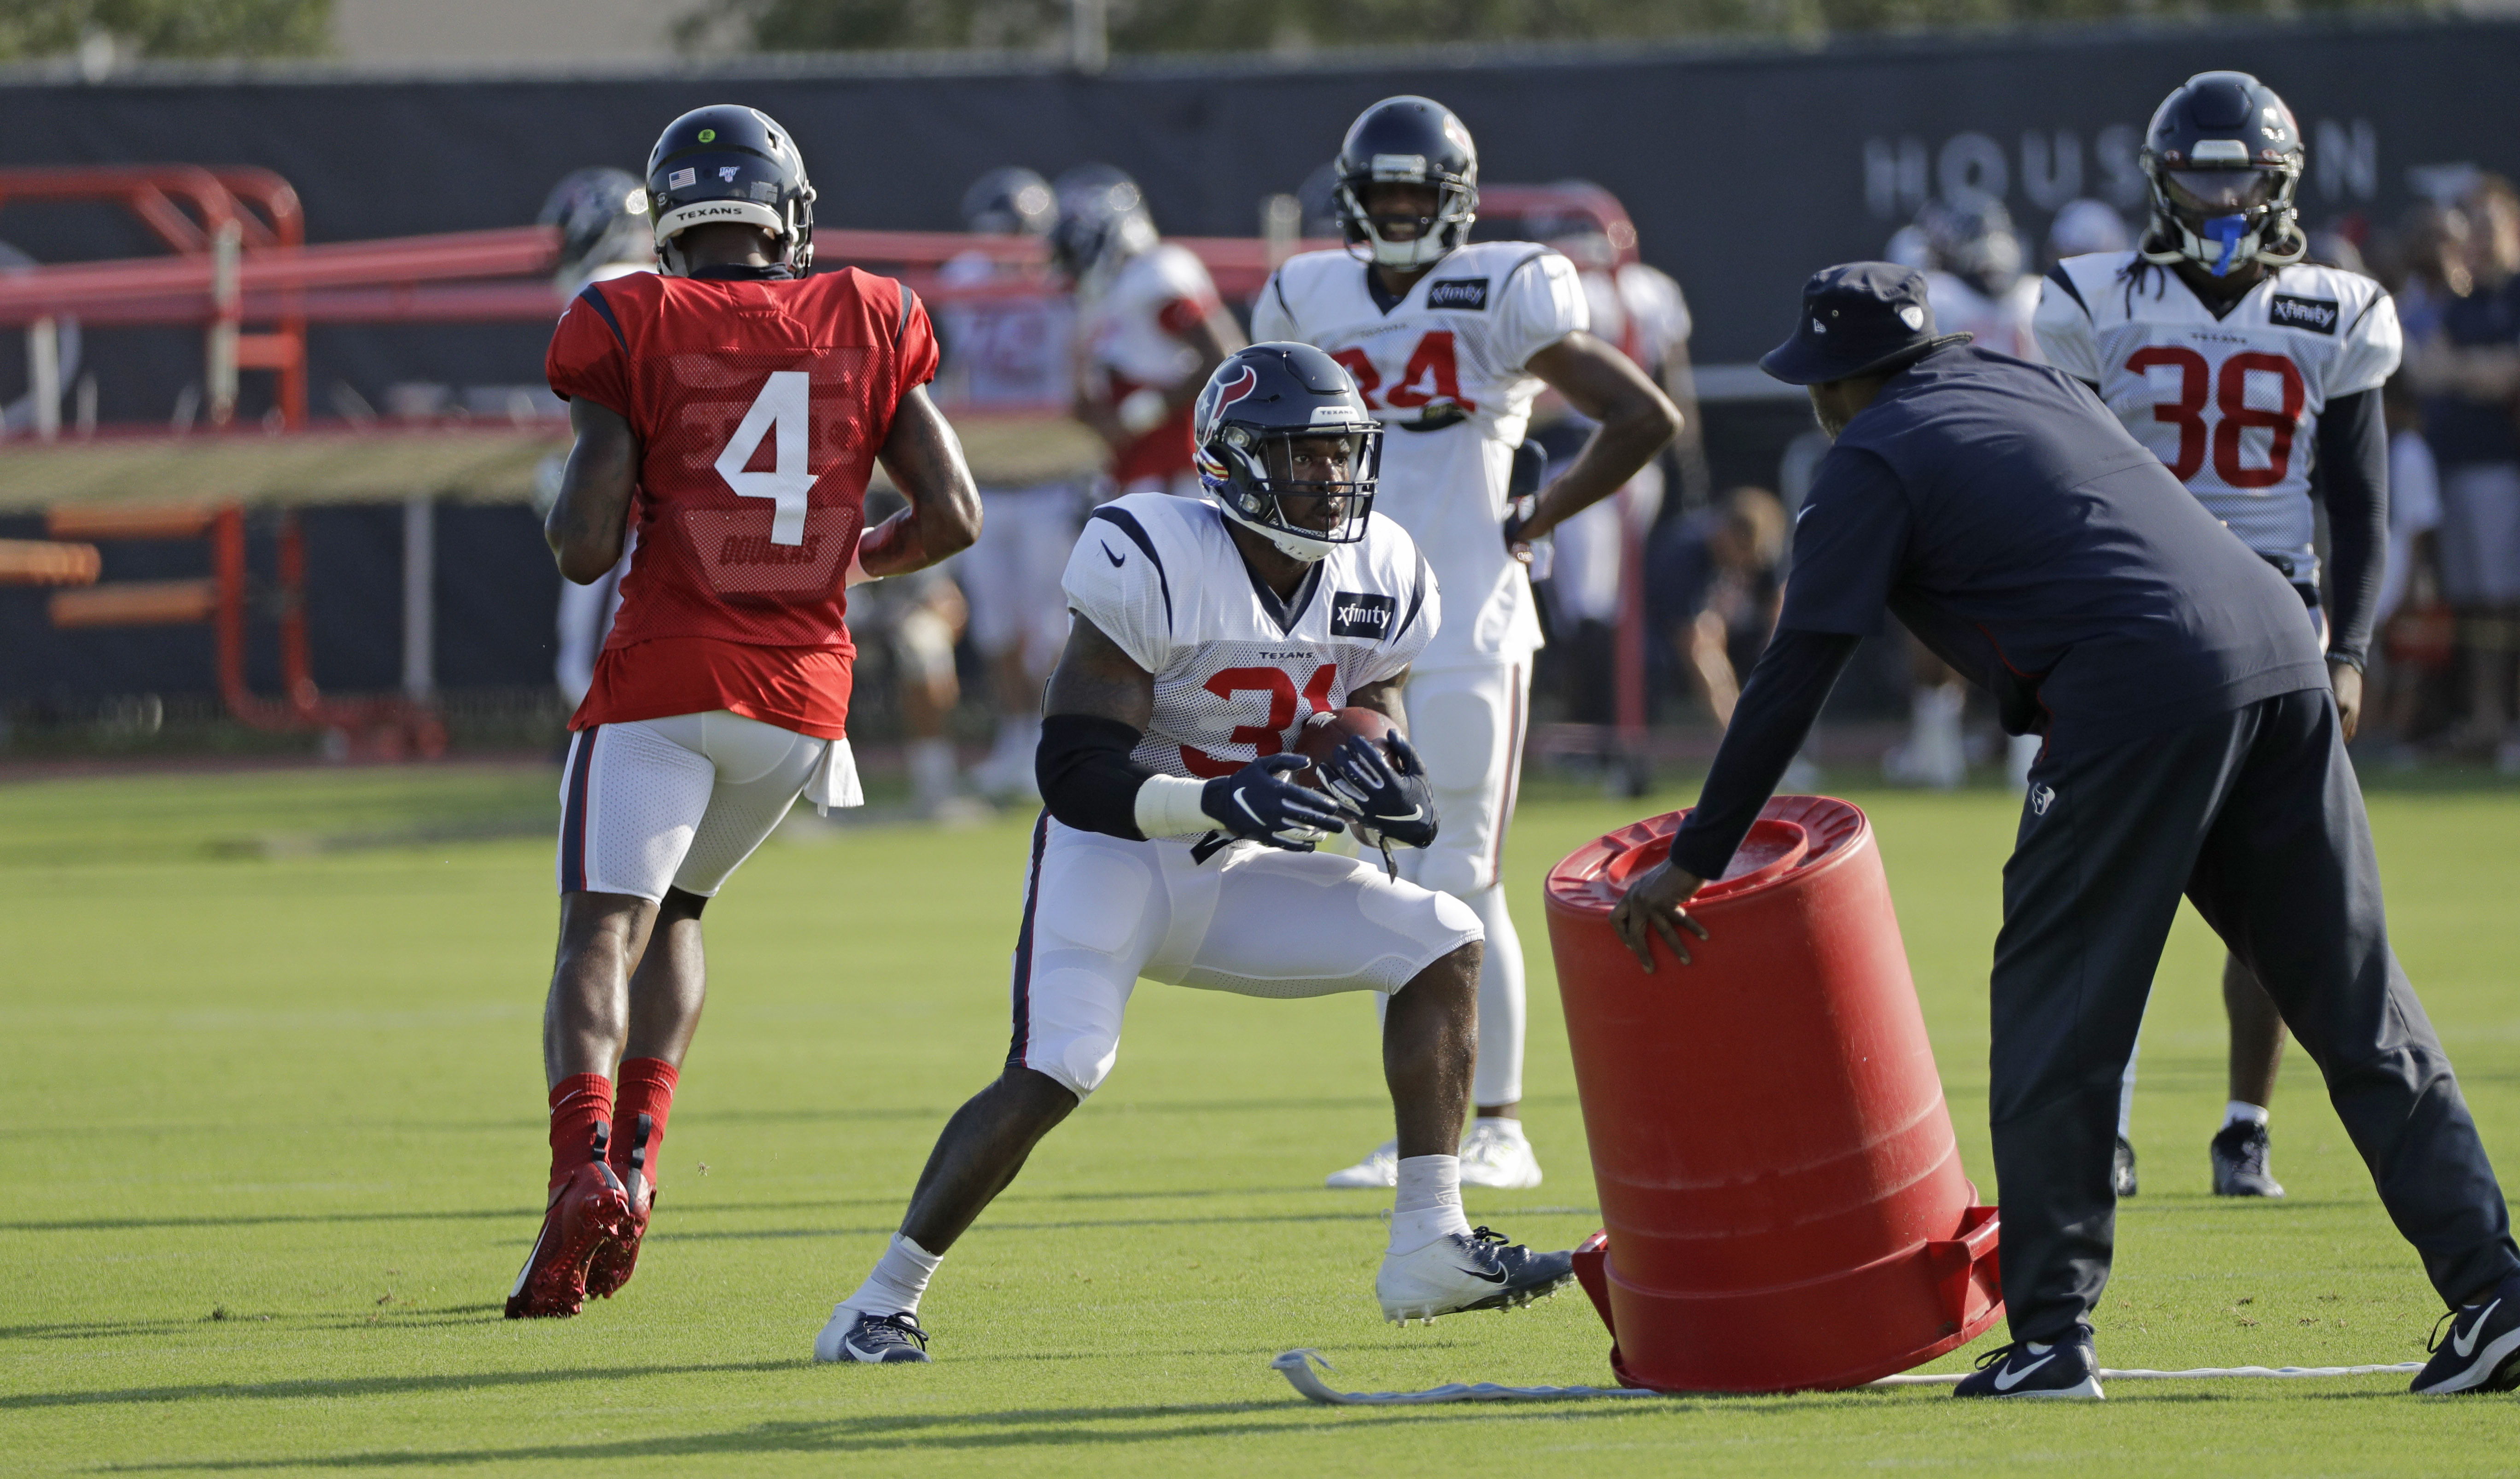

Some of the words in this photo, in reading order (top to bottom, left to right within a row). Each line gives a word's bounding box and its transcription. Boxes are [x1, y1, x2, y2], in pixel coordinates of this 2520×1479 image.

[1864, 117, 2379, 219] HOUSN
[677, 207, 742, 221] TEXANS
[2275, 299, 2336, 328] xfinity
[2125, 345, 2304, 488] 38
[713, 371, 818, 546] 4
[1336, 603, 1391, 629] xfinity
